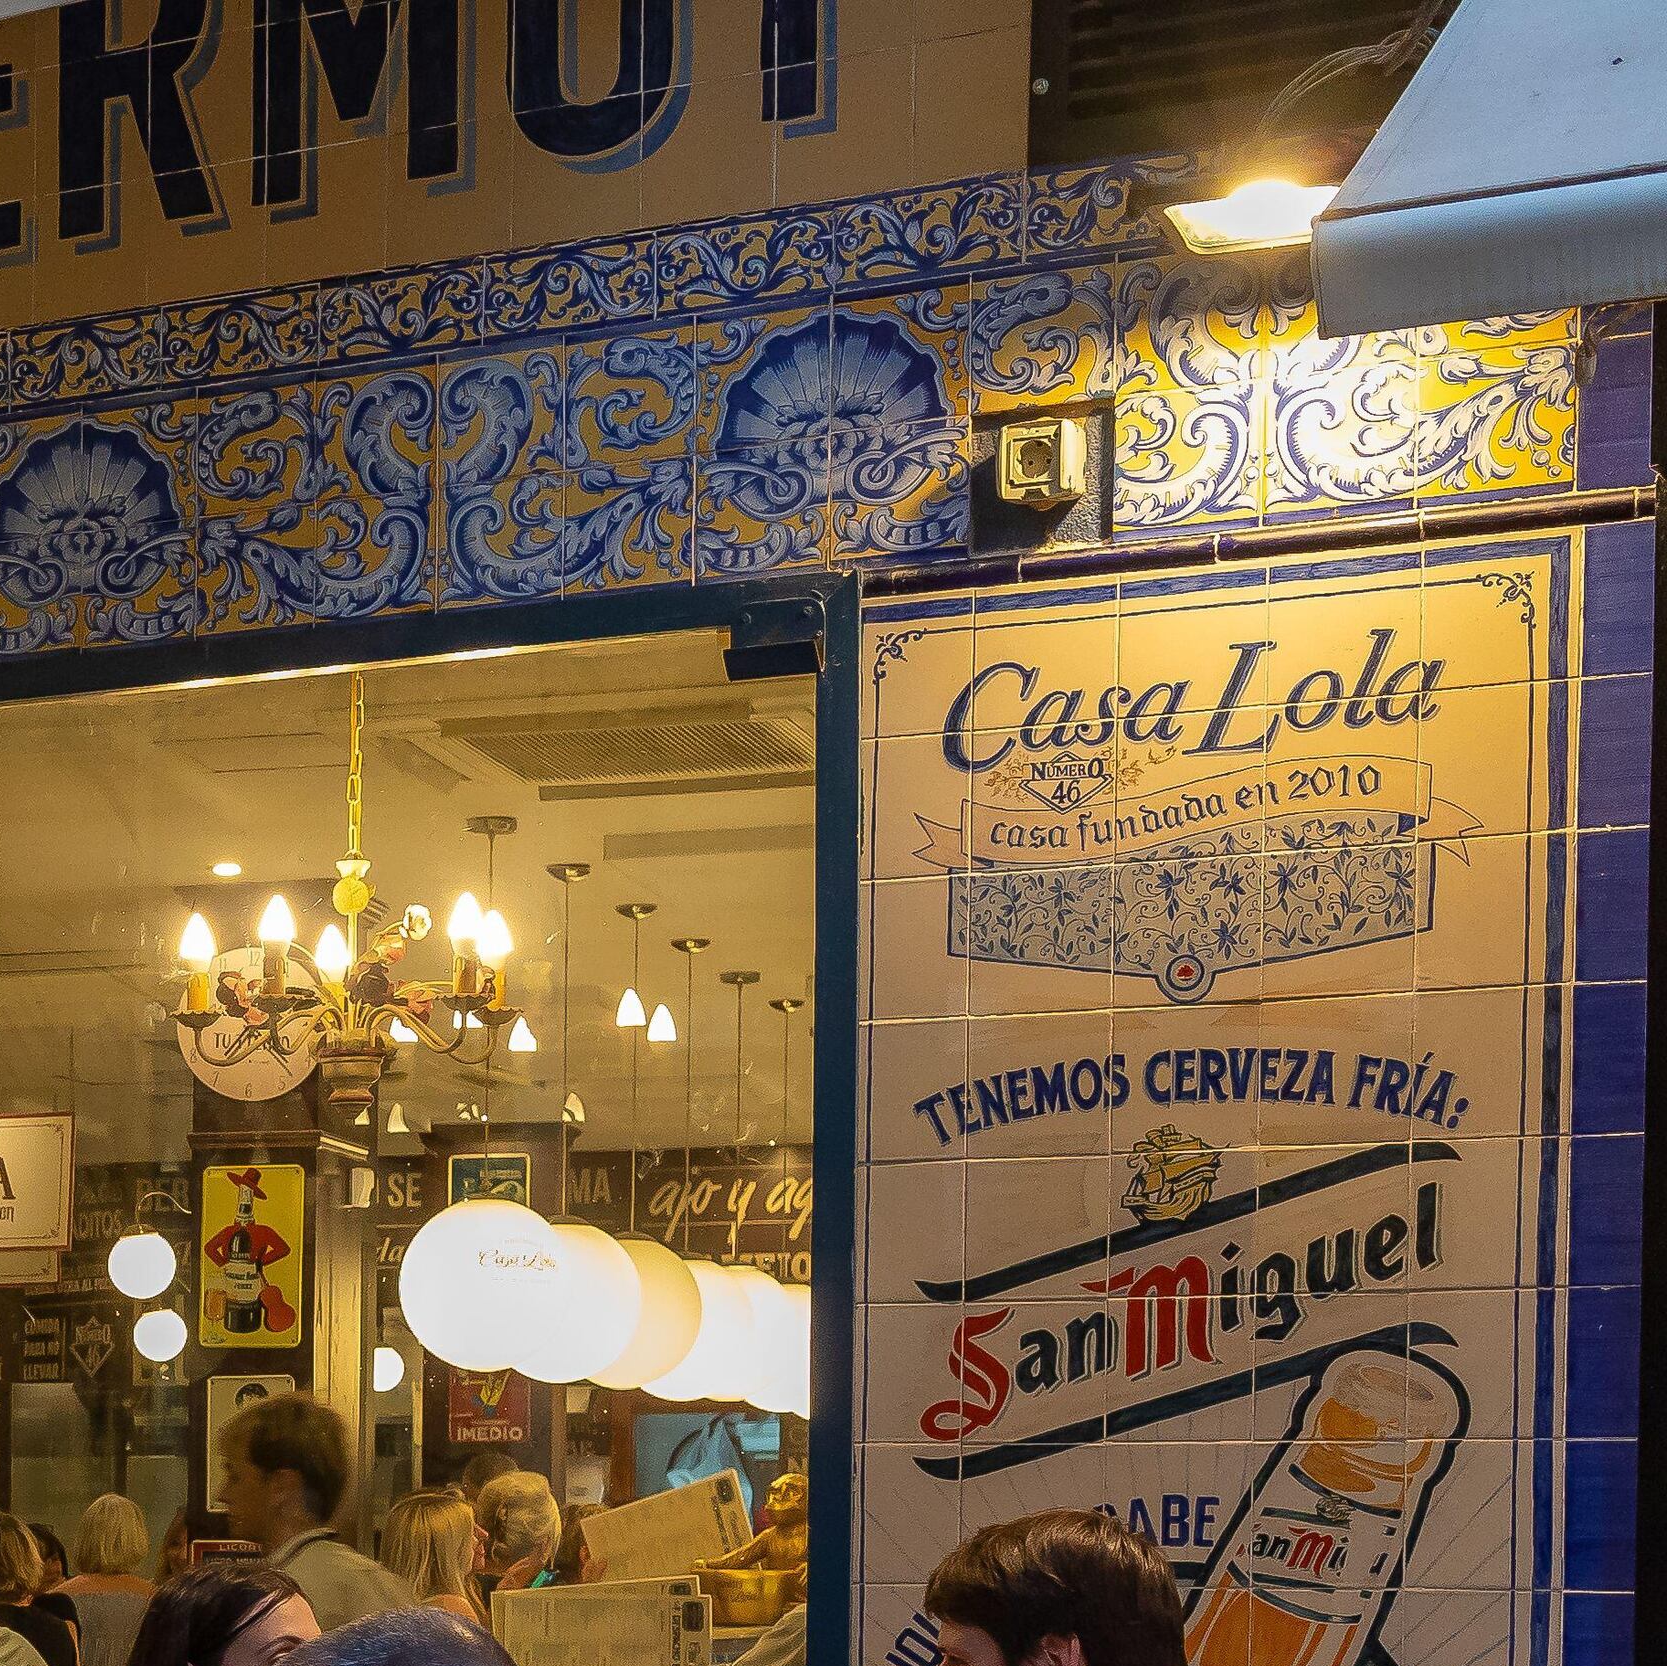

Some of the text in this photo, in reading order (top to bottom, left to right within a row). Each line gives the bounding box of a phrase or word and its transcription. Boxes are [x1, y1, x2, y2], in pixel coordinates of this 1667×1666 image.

[941, 629, 1445, 775] Casa Lola
[989, 763, 1381, 854] casa fundada en 2010
[1050, 780, 1081, 805] 46
[912, 1047, 1472, 1150] TENEMOS CERVEZA FRÍA:
